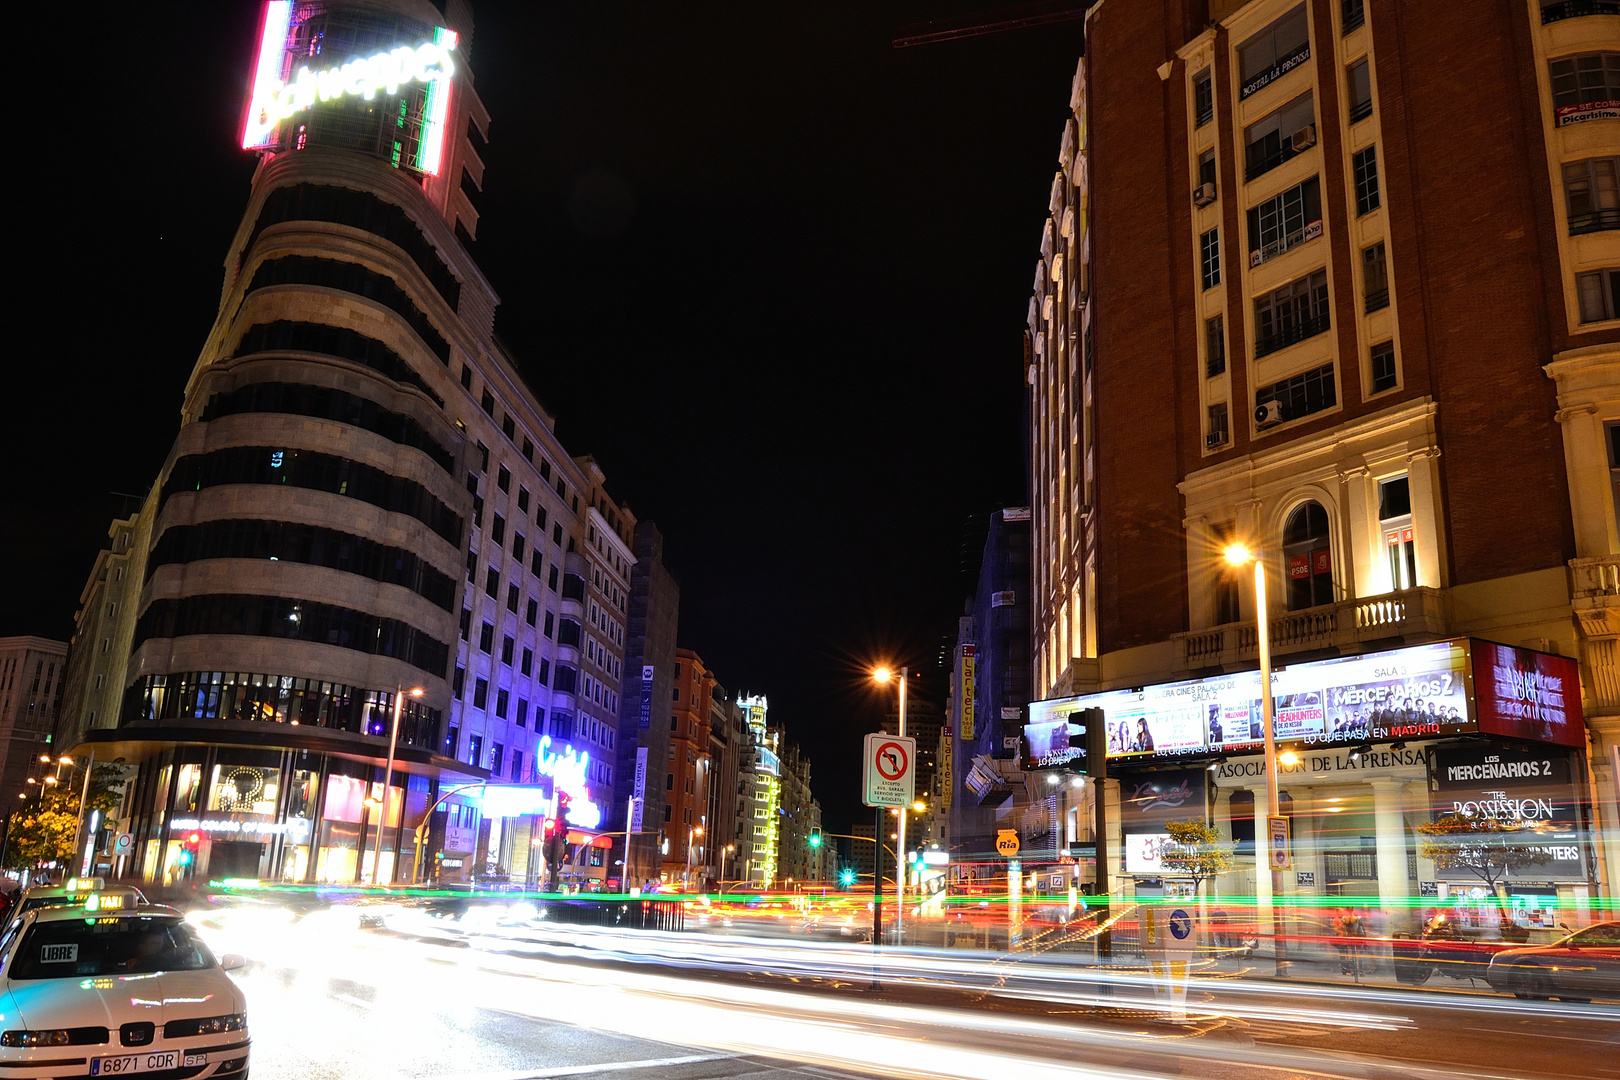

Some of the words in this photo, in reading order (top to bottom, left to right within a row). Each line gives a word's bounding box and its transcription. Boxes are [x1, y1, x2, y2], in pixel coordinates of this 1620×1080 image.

[1242, 74, 1270, 97] HOSTAL
[1271, 67, 1281, 80] LA
[1282, 49, 1310, 73] PRENSA
[1579, 103, 1593, 111] SE
[1291, 565, 1309, 576] PSOE
[1374, 667, 1398, 678] SALA
[1401, 666, 1407, 675] 3
[964, 658, 973, 715] Lartec
[1176, 686, 1196, 697] CINES
[1197, 681, 1226, 693] PALACIO
[1334, 680, 1440, 707] MERCENARIOS
[1440, 674, 1454, 697] 2
[1191, 693, 1211, 702] SALA
[1212, 692, 1218, 700] 2
[1053, 711, 1068, 720] SALA
[1277, 708, 1323, 723] HEADHUNTERS
[1304, 733, 1317, 745] LO
[1319, 731, 1344, 744] QUE
[1343, 729, 1370, 742] PASA
[1373, 727, 1388, 738] EN
[1391, 723, 1440, 737] MADRID
[1209, 744, 1222, 752] EN
[1217, 757, 1306, 777] ASOCIAIN
[1312, 756, 1332, 772] DE
[1336, 754, 1355, 770] LA
[1362, 750, 1427, 769] PRENSA
[1484, 755, 1500, 763] LOS
[1447, 762, 1540, 781] MERCENARIOS
[1541, 760, 1552, 776] 2
[770, 781, 778, 818] HOTEL
[1492, 791, 1507, 799] THE
[1453, 798, 1554, 820] POSSESSION
[200, 819, 240, 832] COLORS
[242, 821, 257, 832] OF
[999, 839, 1017, 849] Ria
[77, 879, 94, 891] TAXI
[100, 895, 122, 909] TAXI
[41, 946, 73, 961] LIBRE
[103, 1058, 138, 1073] 6871
[147, 1054, 173, 1069] CDR
[186, 1055, 205, 1066] SP
